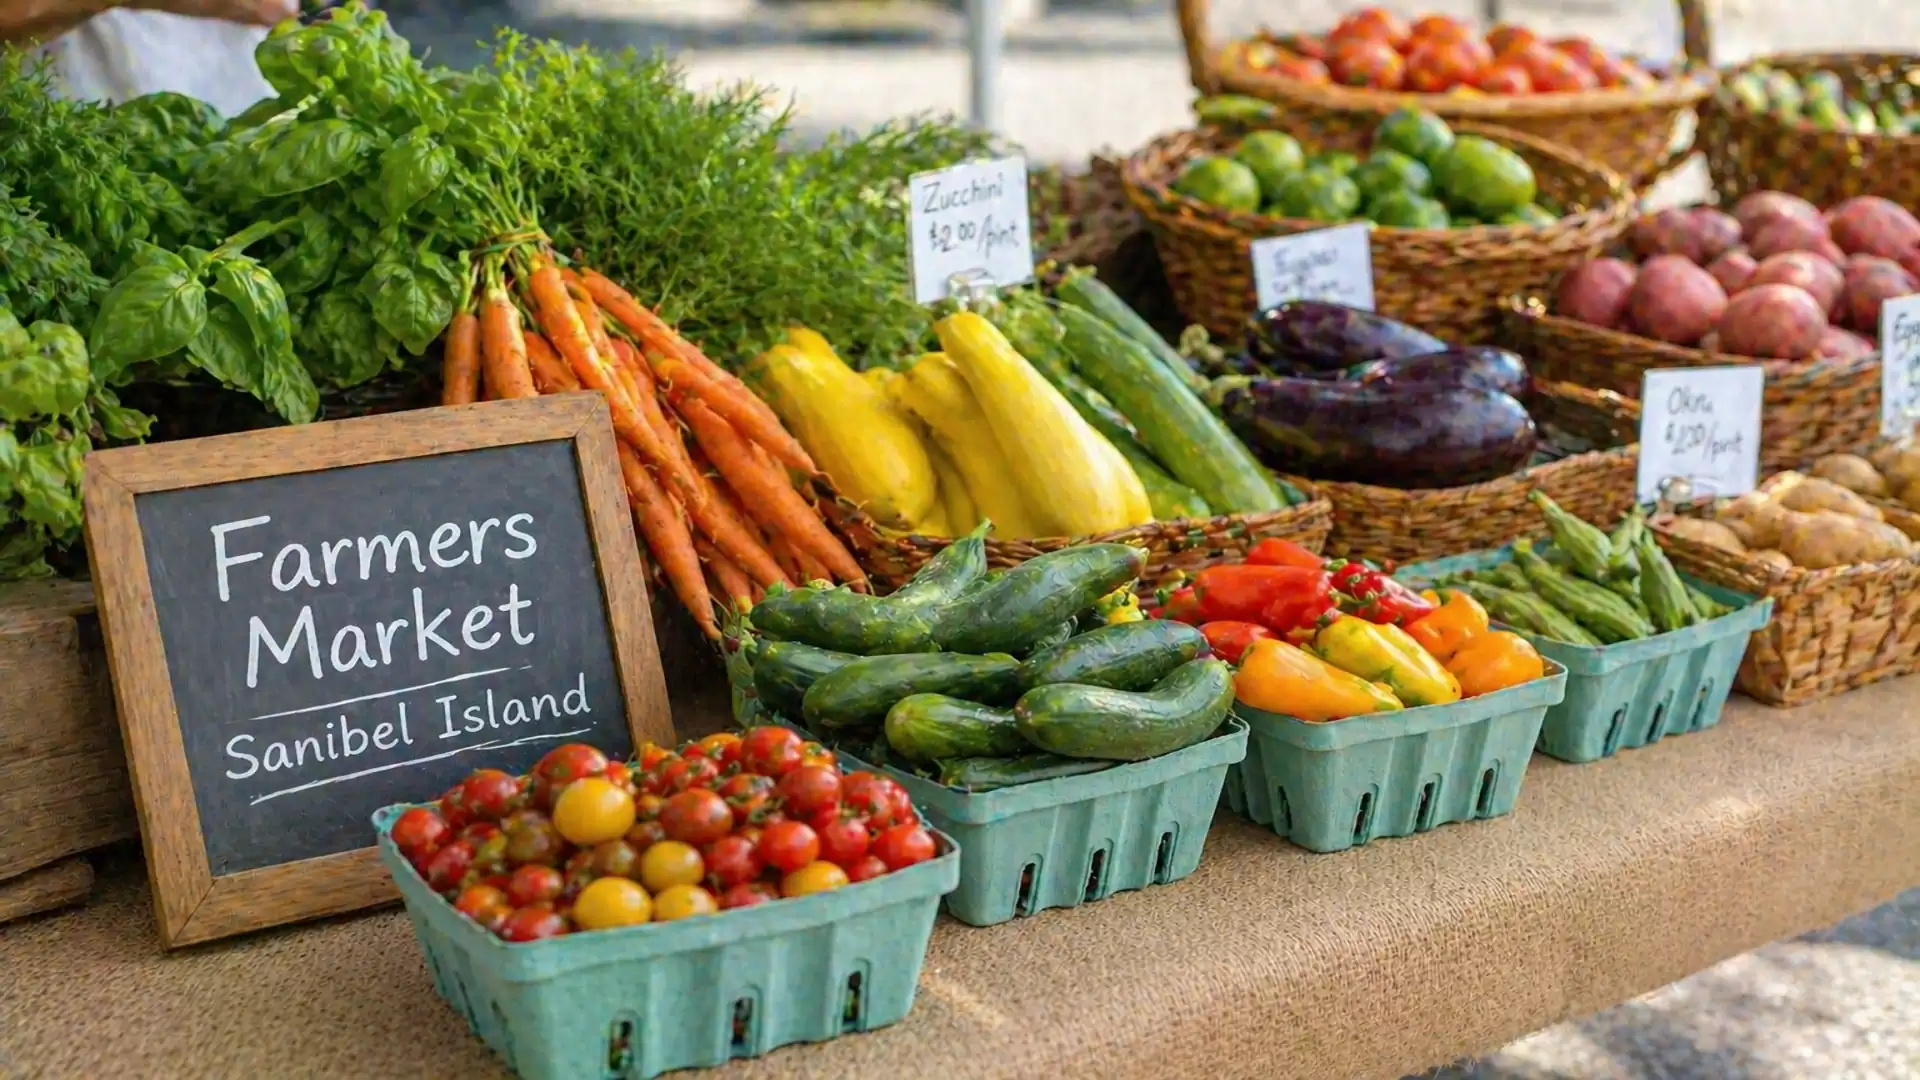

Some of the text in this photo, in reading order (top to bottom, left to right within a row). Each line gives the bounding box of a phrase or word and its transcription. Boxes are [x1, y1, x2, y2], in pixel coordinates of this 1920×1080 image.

[922, 171, 1004, 214] Zucchini
[210, 512, 538, 602] Farmers
[246, 583, 536, 689] Market
[225, 672, 592, 780] Sanibel Island
